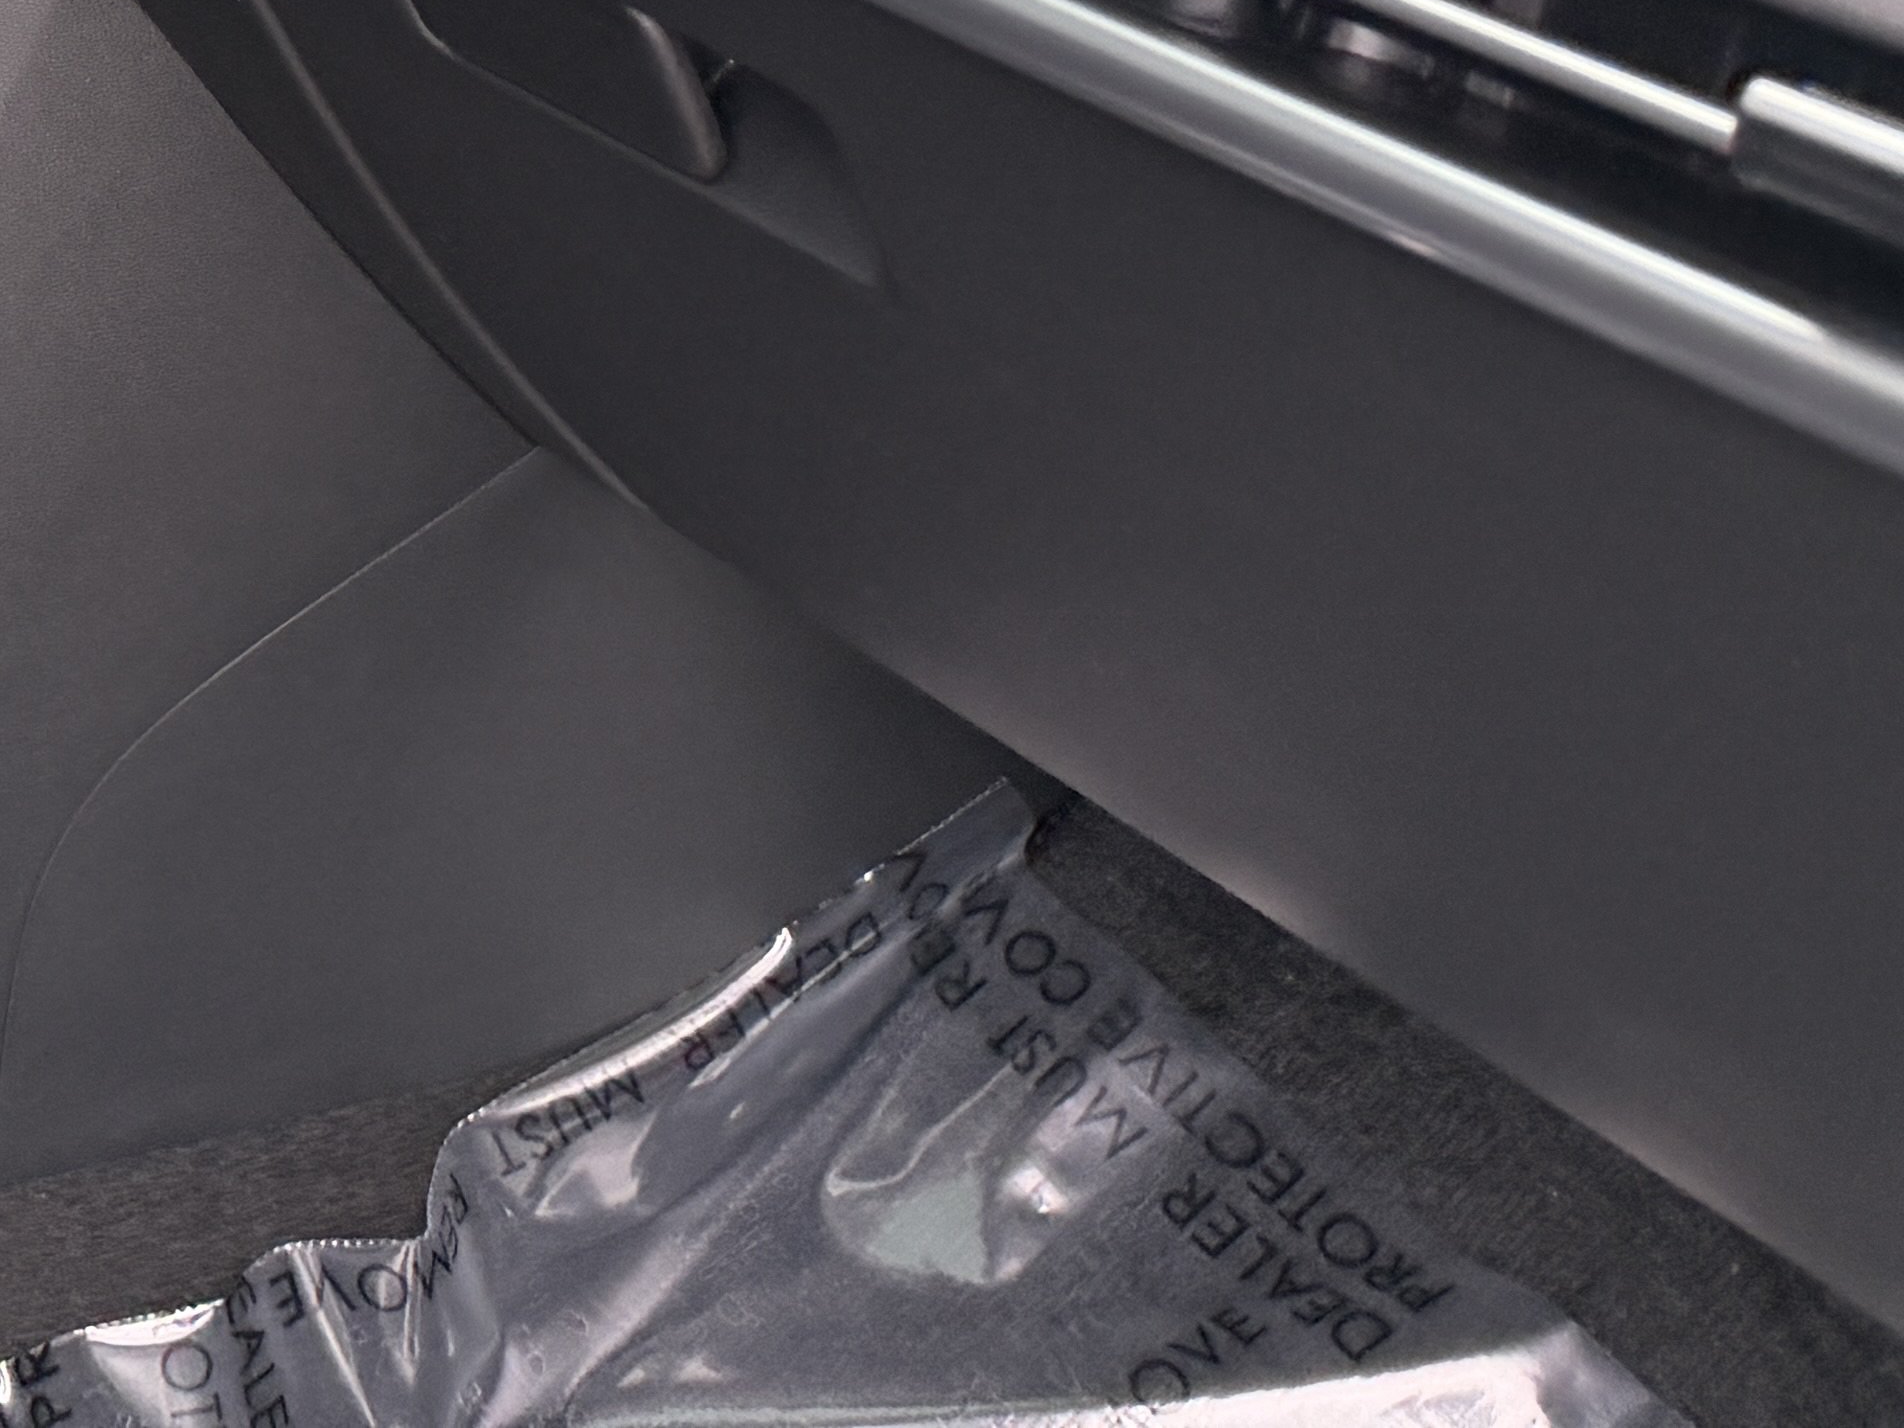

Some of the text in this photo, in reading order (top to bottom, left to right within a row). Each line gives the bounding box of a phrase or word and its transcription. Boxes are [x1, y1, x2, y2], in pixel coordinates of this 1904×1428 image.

[269, 912, 883, 1328] DEALER MUST REMOVE
[987, 1015, 1149, 1161] MUST
[1085, 997, 1455, 1314] PROTECTIVE
[1160, 1174, 1394, 1361] DEALER
